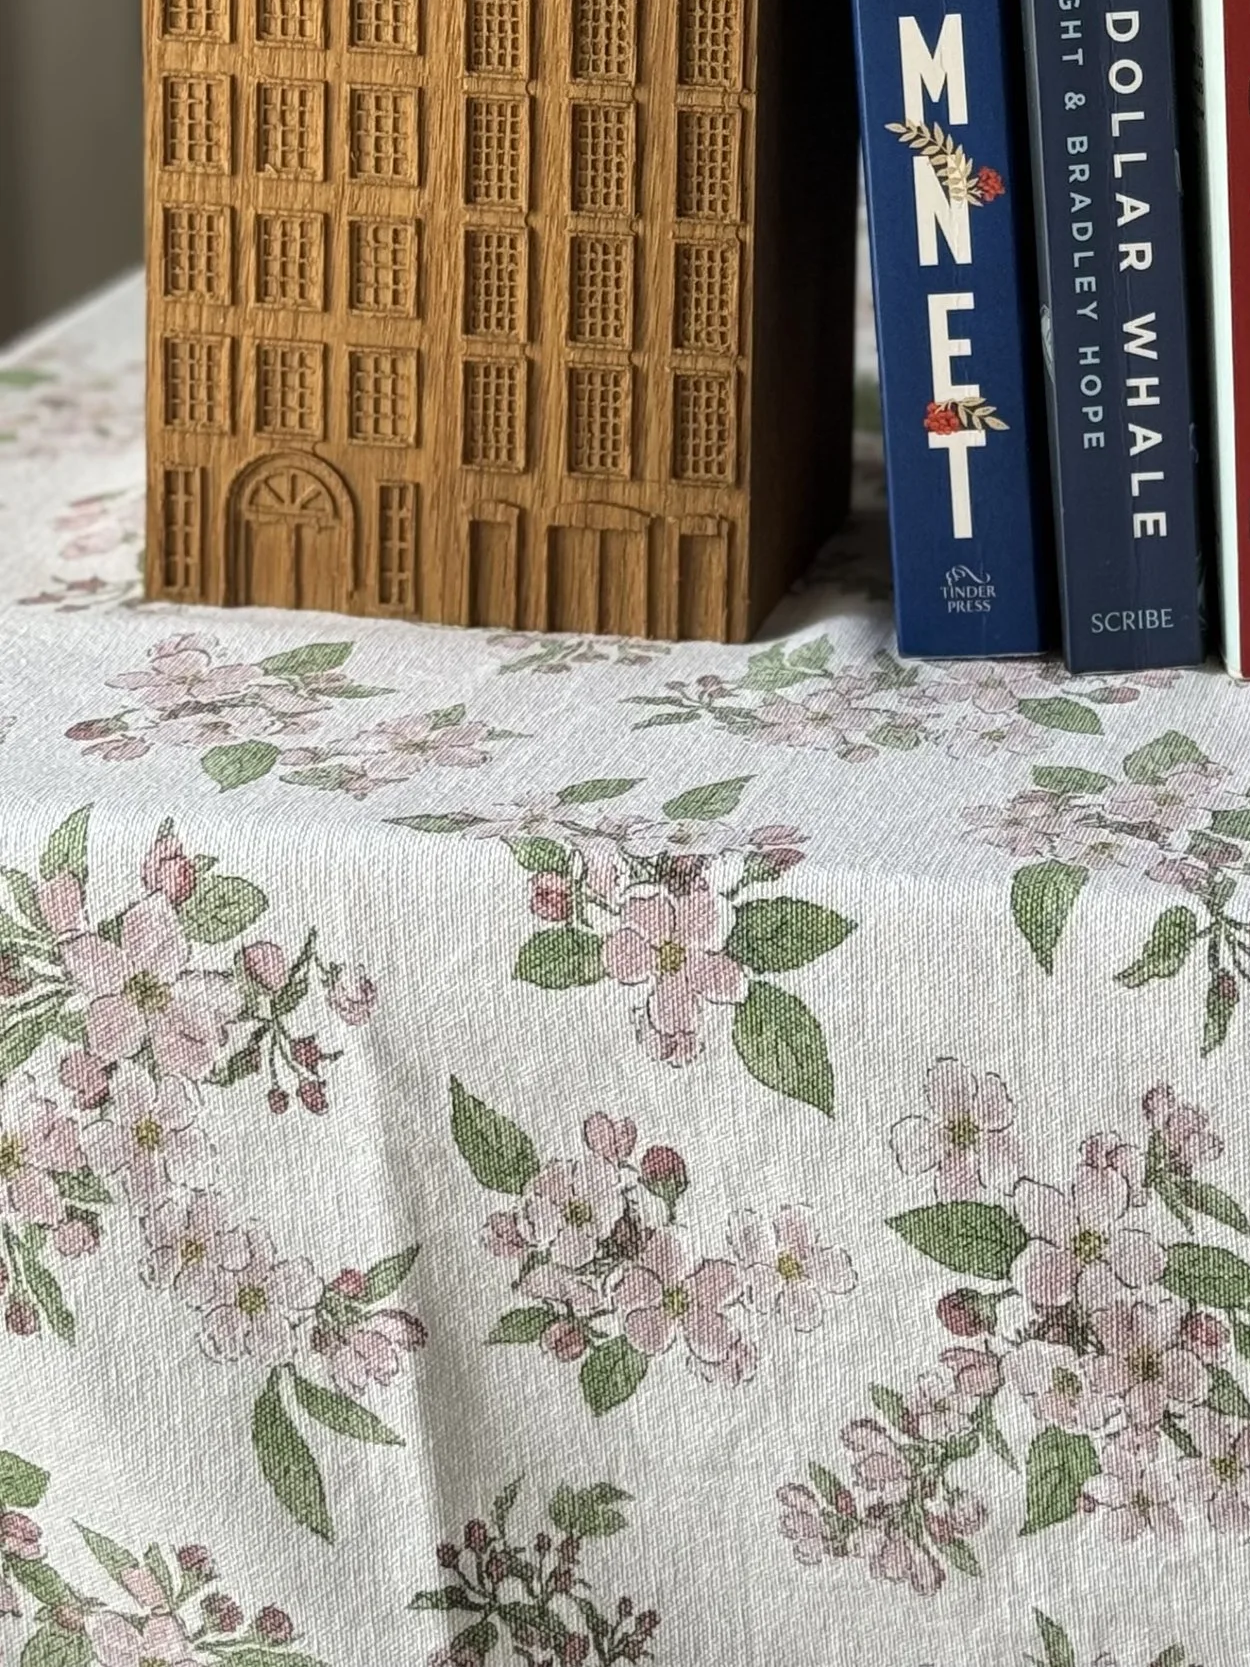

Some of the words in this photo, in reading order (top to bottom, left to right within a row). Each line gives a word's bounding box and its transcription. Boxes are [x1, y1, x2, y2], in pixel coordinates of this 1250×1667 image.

[1064, 91, 1086, 111] &
[1105, 10, 1154, 272] DOLLAR
[1066, 135, 1099, 320] BRADLEY
[1078, 345, 1105, 450] HOPE
[1122, 312, 1167, 539] WHALE
[940, 585, 996, 599] TINDER
[947, 599, 991, 613] PRESS
[1091, 608, 1174, 633] SCRIBE
